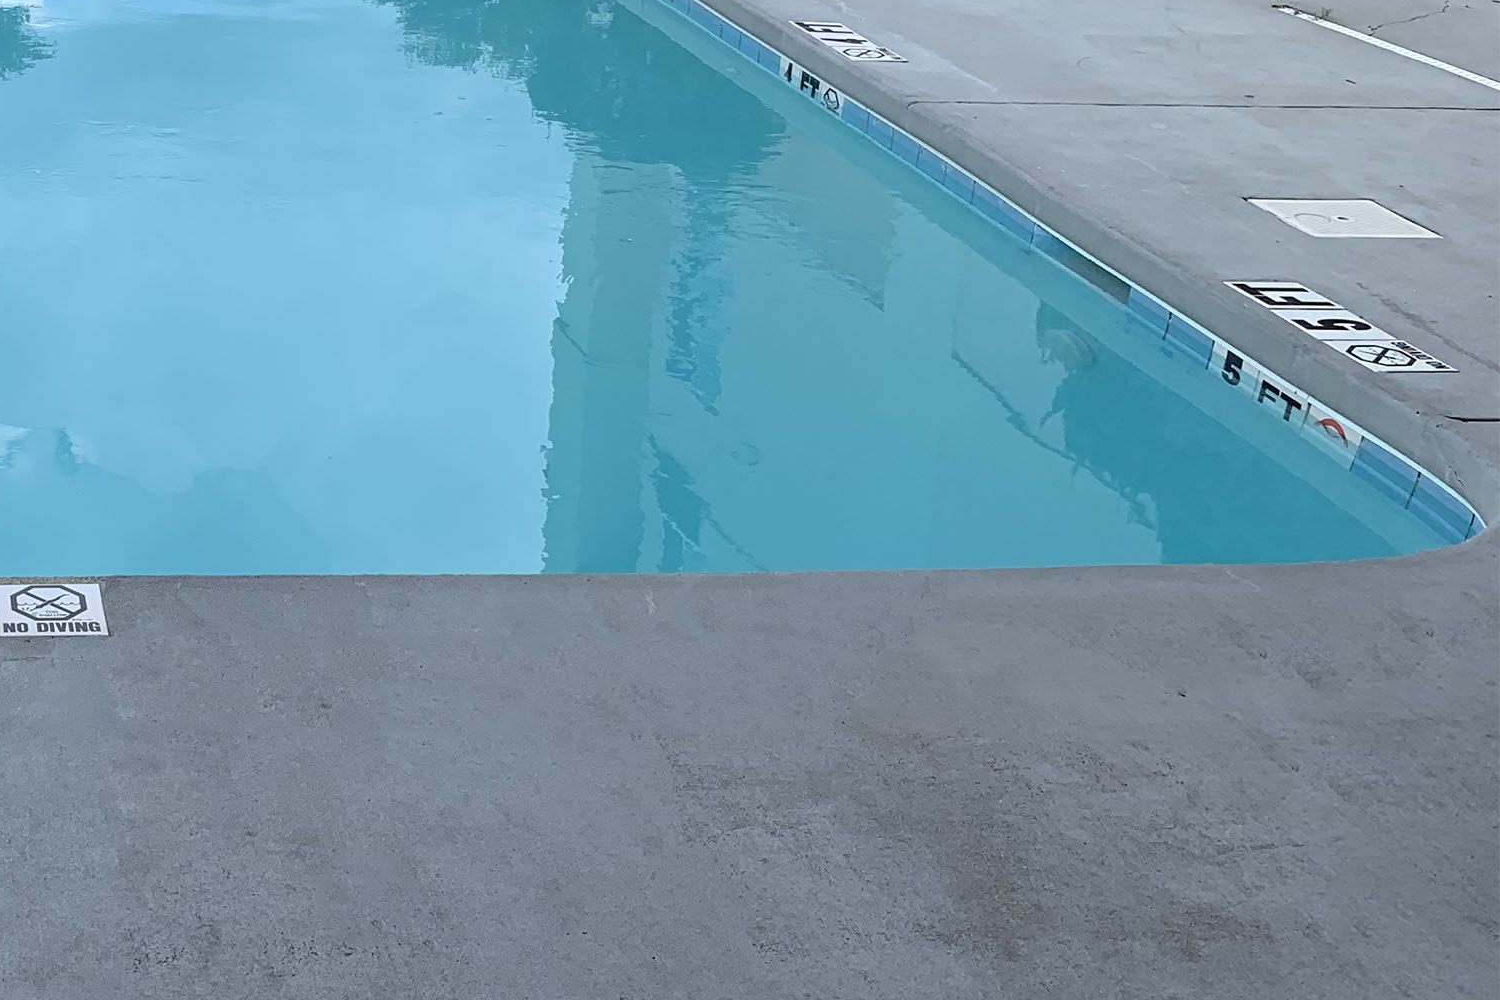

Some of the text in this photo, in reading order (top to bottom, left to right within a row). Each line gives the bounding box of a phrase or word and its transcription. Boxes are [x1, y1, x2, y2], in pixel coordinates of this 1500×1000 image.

[800, 70, 820, 99] FT
[1232, 282, 1372, 331] 5 FT
[1222, 350, 1302, 423] 5 FT
[3, 621, 102, 633] NO DIVING
